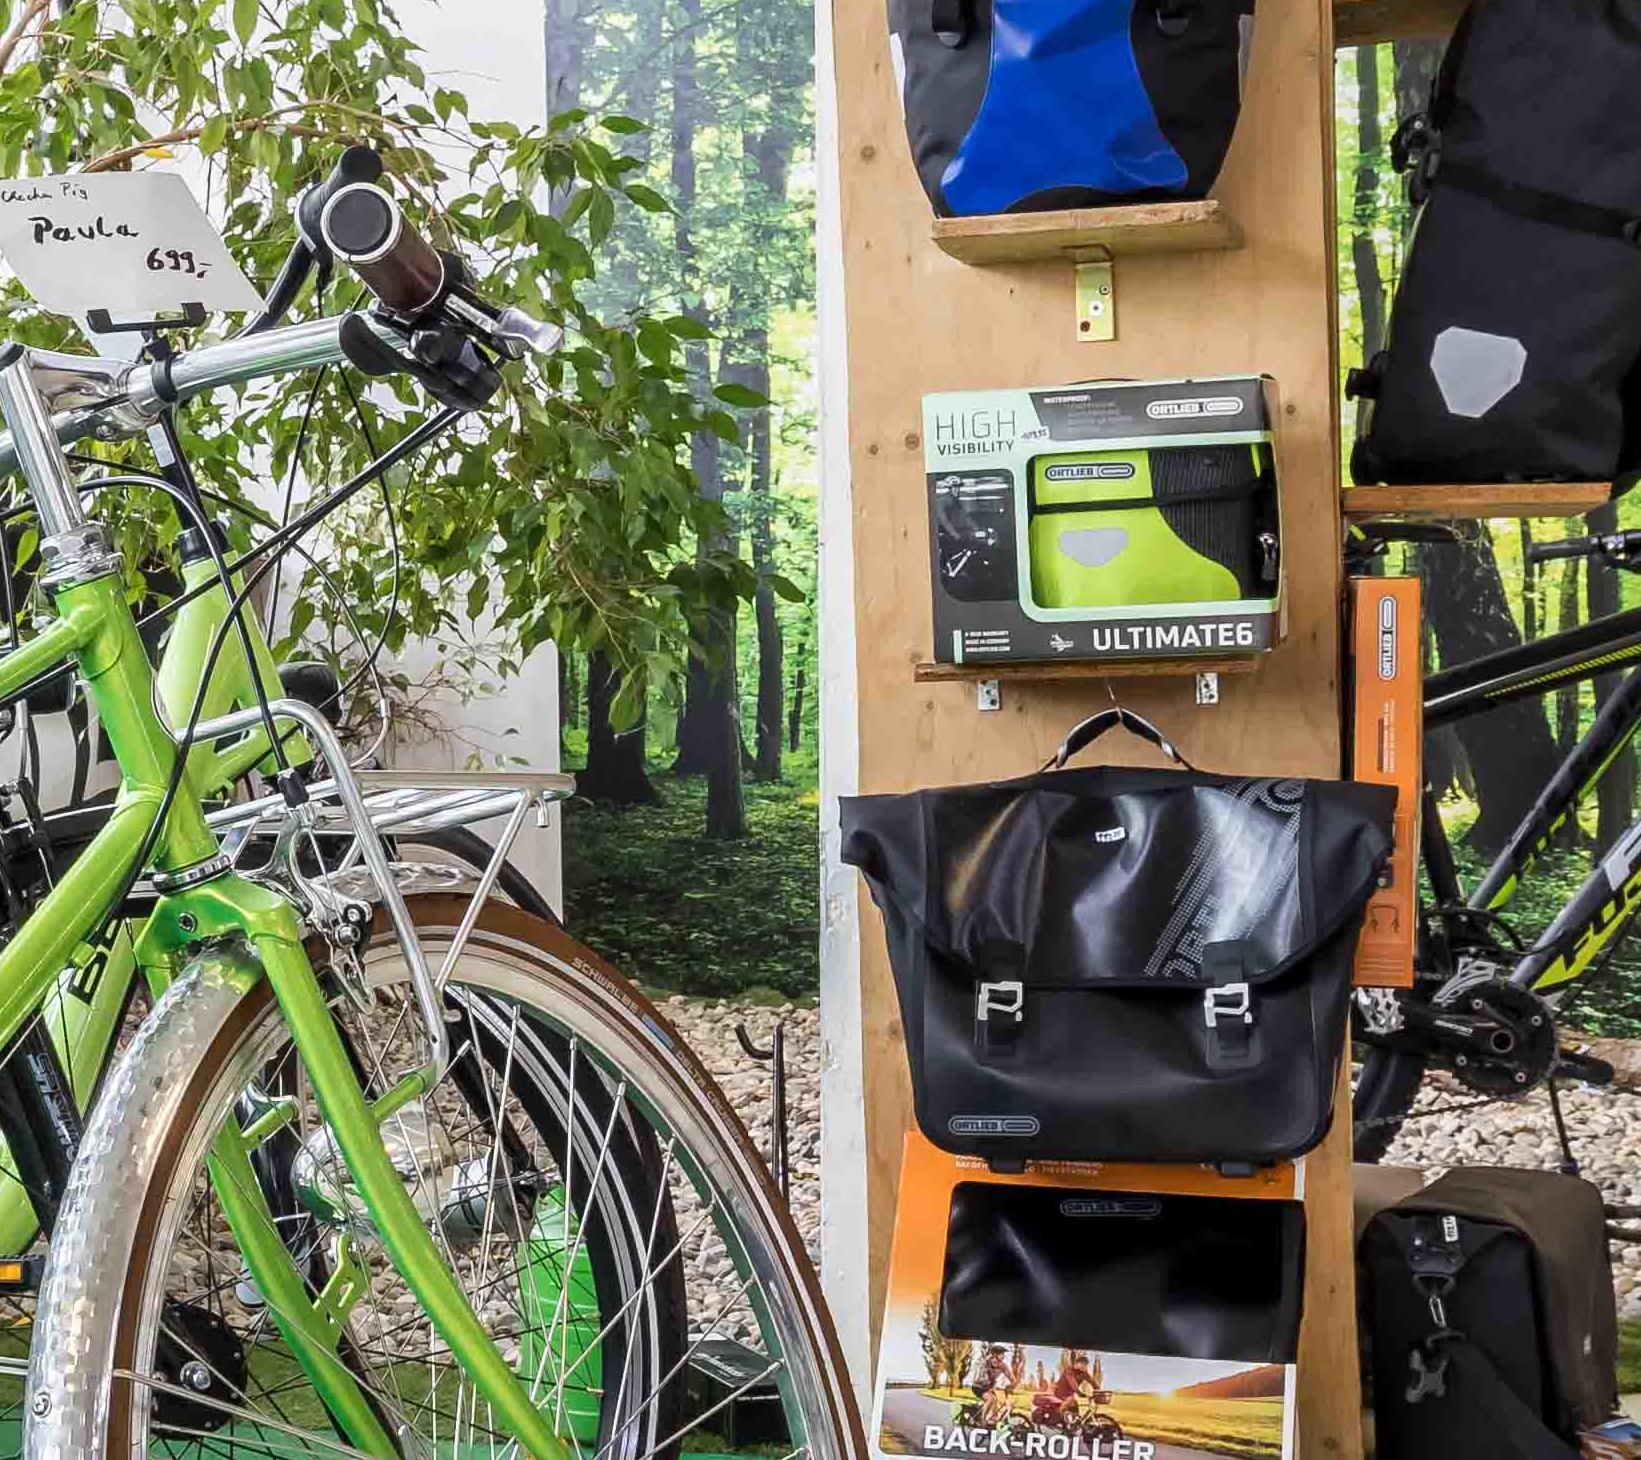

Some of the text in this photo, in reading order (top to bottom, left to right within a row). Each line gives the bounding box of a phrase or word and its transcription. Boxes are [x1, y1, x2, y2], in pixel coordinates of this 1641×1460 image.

[935, 409, 1016, 441] HIGH
[937, 441, 1015, 456] VISIBILITY
[1049, 467, 1094, 478] ORTLIEB
[571, 957, 642, 1017] SCHWALBE
